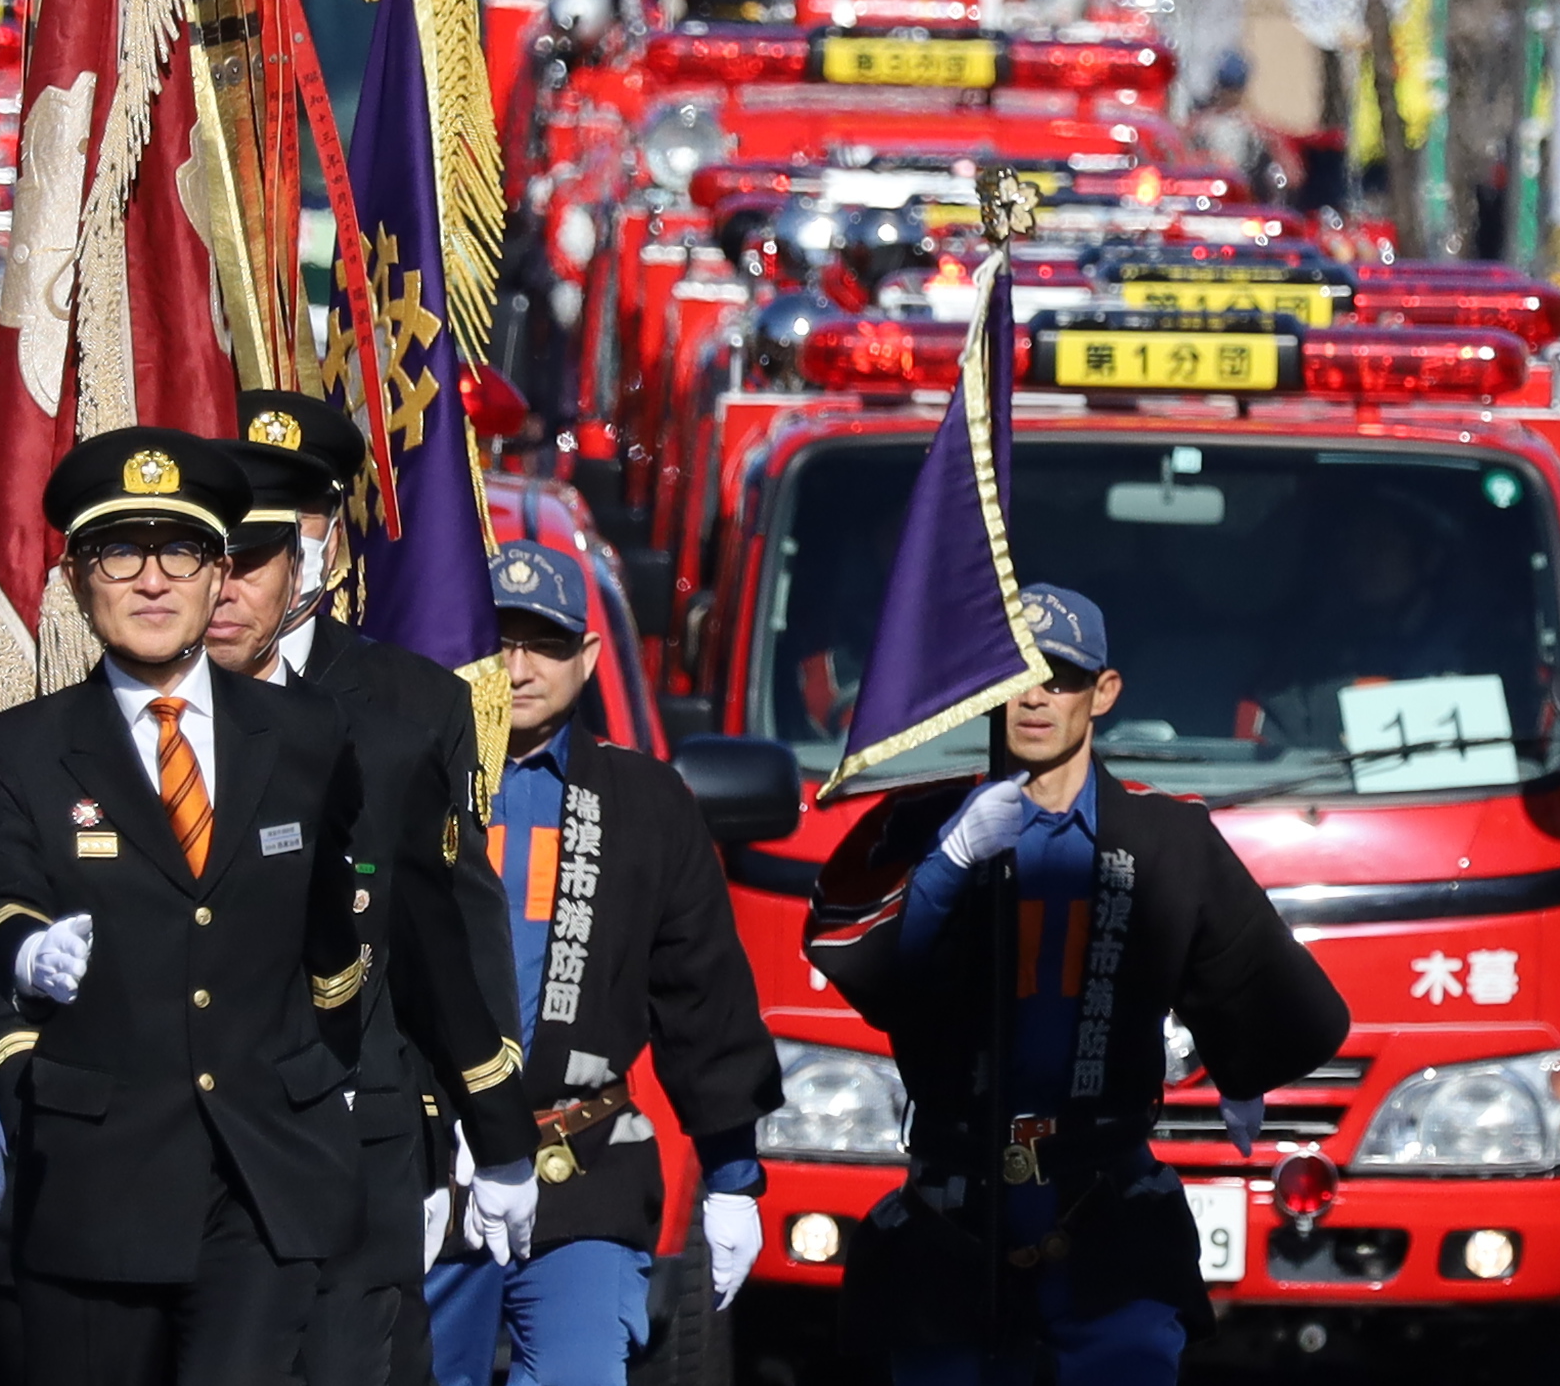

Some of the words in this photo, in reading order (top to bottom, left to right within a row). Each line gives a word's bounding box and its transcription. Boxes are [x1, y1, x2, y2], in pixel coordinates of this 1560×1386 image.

[1084, 343, 1252, 381] 第1分団
[509, 548, 532, 562] City
[1381, 703, 1468, 762] 11
[542, 784, 602, 1024] 瑞浪市消防団
